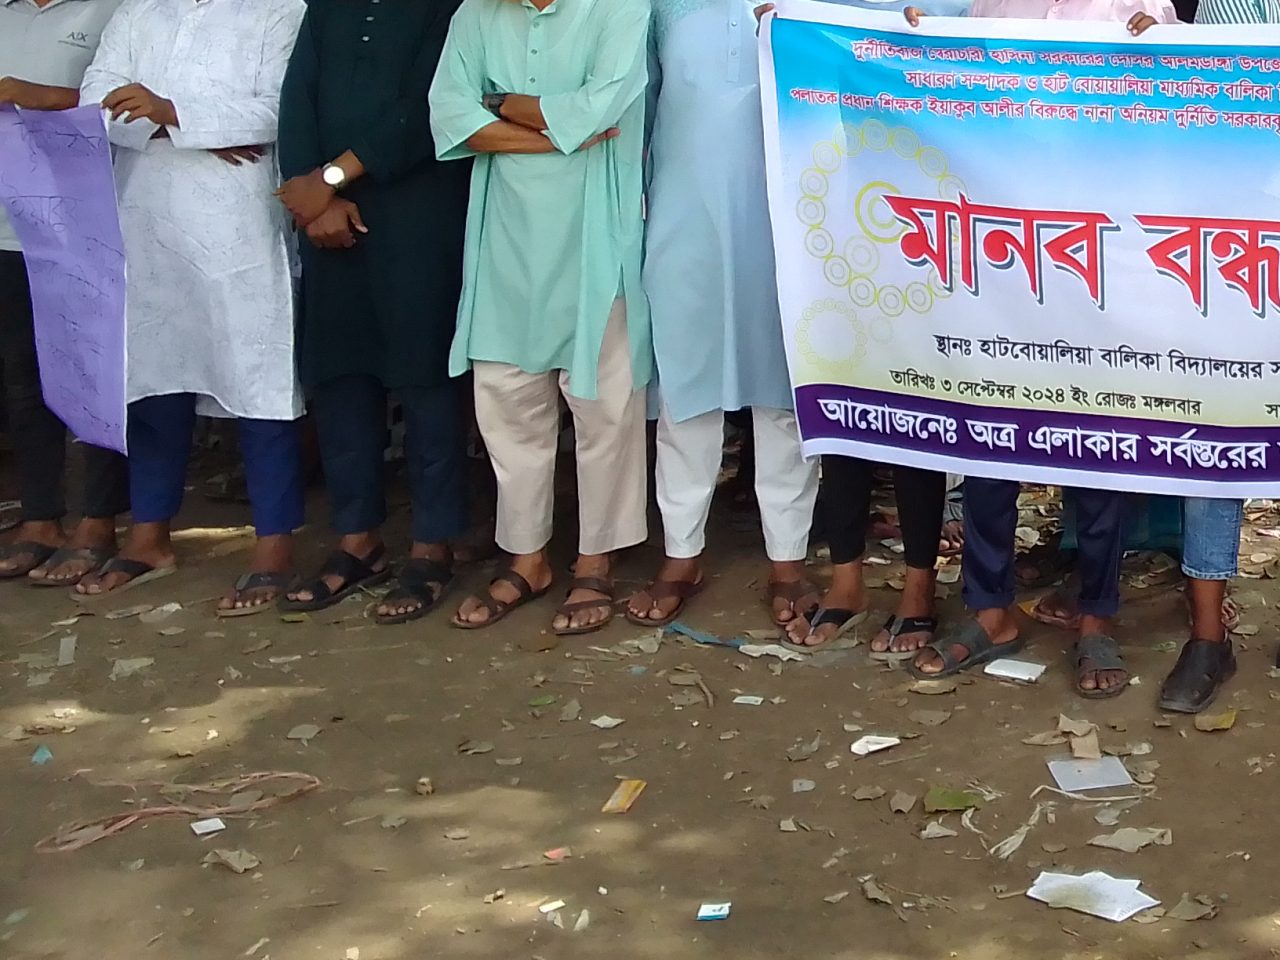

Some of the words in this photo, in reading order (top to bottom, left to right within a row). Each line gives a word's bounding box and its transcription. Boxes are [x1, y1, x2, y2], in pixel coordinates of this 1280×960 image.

[790, 88, 838, 104] পলাতক
[842, 94, 875, 110] প্রধান
[878, 92, 922, 112] শিক্ষক
[928, 96, 976, 119] ইয়াকুব
[981, 98, 1025, 119] আলীর
[1030, 99, 1079, 121] বিরুদ্ধে
[1083, 105, 1114, 122] নানা
[1119, 103, 1170, 124] অনিয়ম
[905, 70, 957, 88] সাধারণ
[960, 72, 1020, 91] সম্পাদক
[1025, 75, 1037, 90] ও
[1042, 72, 1069, 93] হাট
[1158, 76, 1219, 99] মাধ্যমিক
[1223, 78, 1274, 102] বালিকা
[880, 191, 1121, 312] মানব
[977, 334, 1093, 366] হাটবোয়ালিয়া
[1098, 344, 1162, 372] বালিকা
[1167, 349, 1264, 379] বিদ্যালয়ের
[940, 378, 952, 392] ৩
[957, 377, 1016, 401] সেপ্টেম্বর
[1021, 385, 1065, 404] ২০২৪
[1070, 384, 1090, 407] ইং
[1141, 395, 1202, 416] মঙ্গলবার
[965, 418, 1020, 451] অত্র
[1028, 425, 1141, 463] এলাকার
[1147, 428, 1270, 469] সর্বস্তরের
